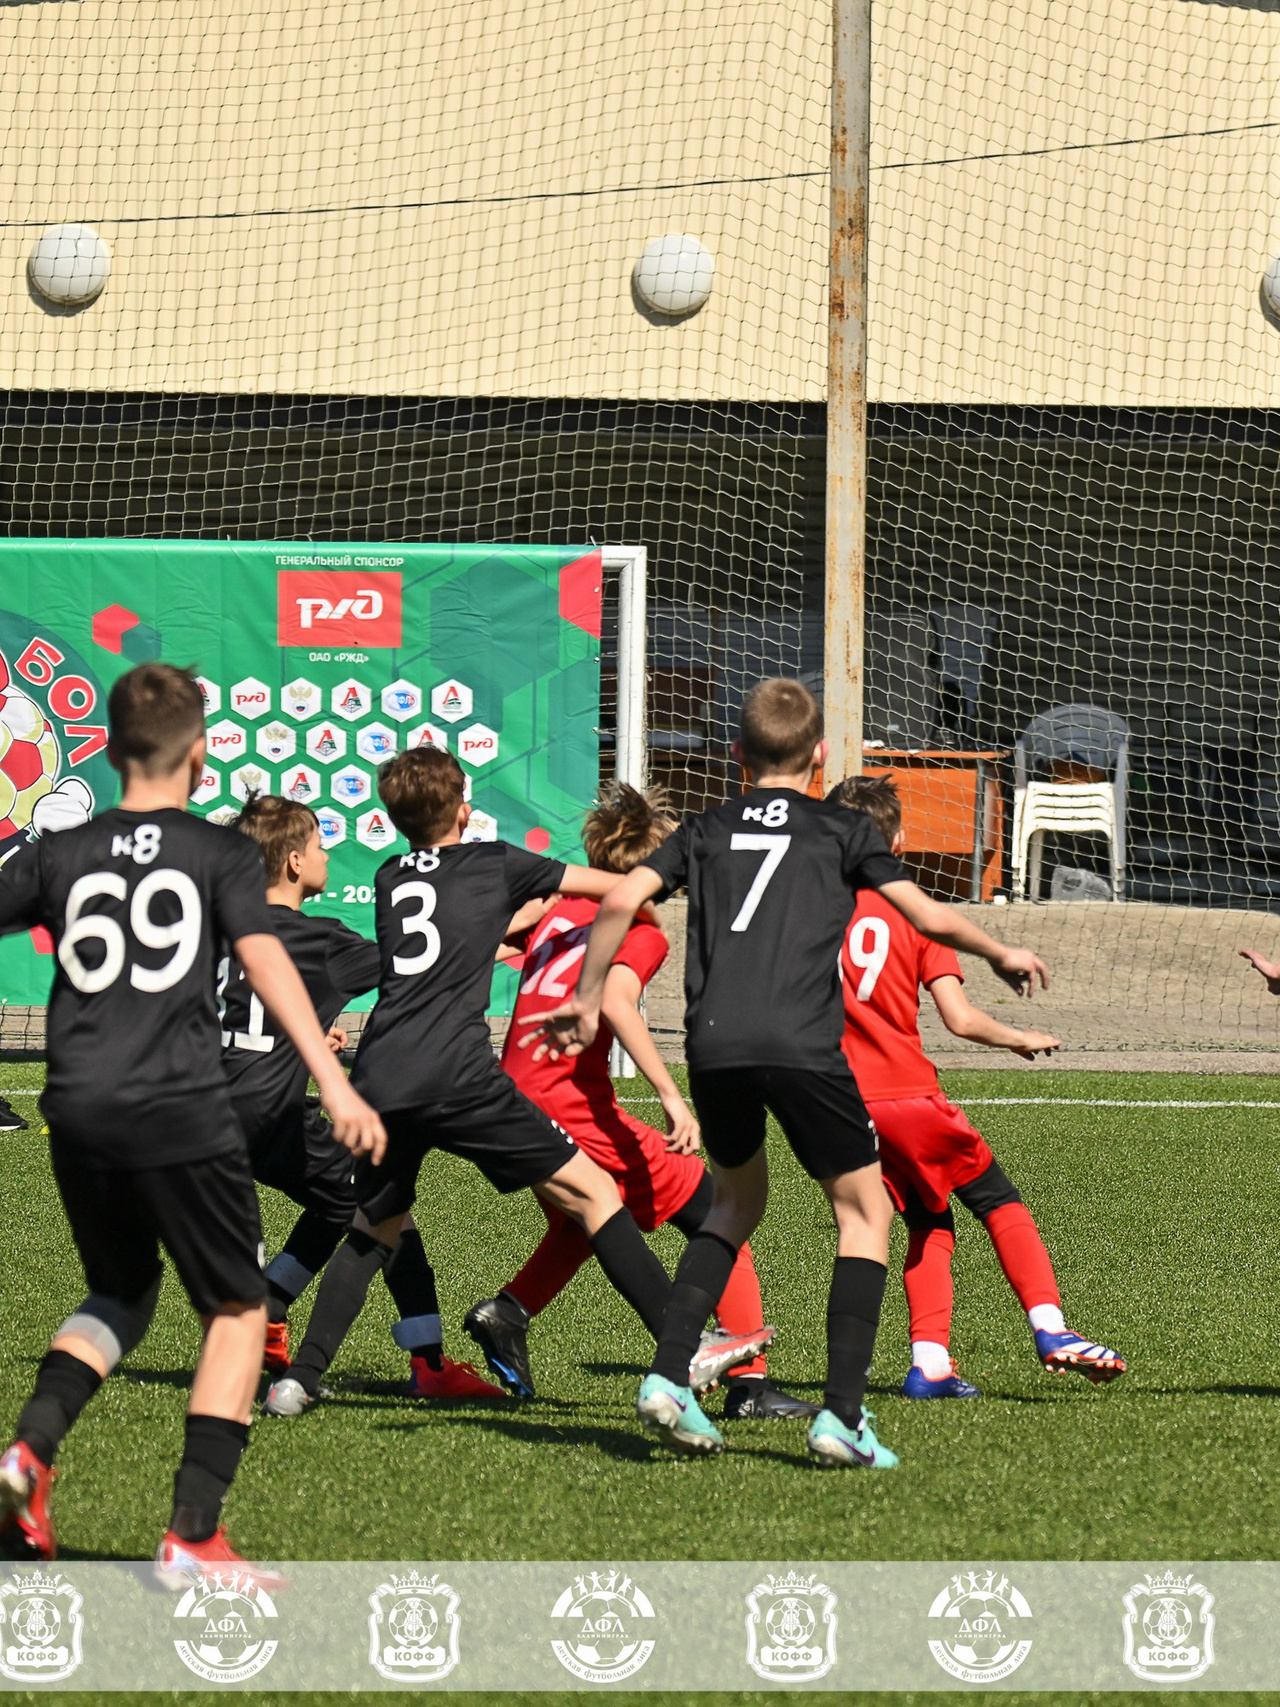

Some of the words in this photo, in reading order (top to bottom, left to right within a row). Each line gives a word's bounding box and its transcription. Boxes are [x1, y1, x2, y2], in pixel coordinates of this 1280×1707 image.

[275, 555, 352, 566] ГЕНЕРАЛЬНЫЙ
[354, 557, 404, 567] СПОНСОР
[309, 653, 331, 662] ОАО
[391, 880, 441, 975] 3
[730, 833, 792, 932] 7
[58, 868, 202, 993] 69
